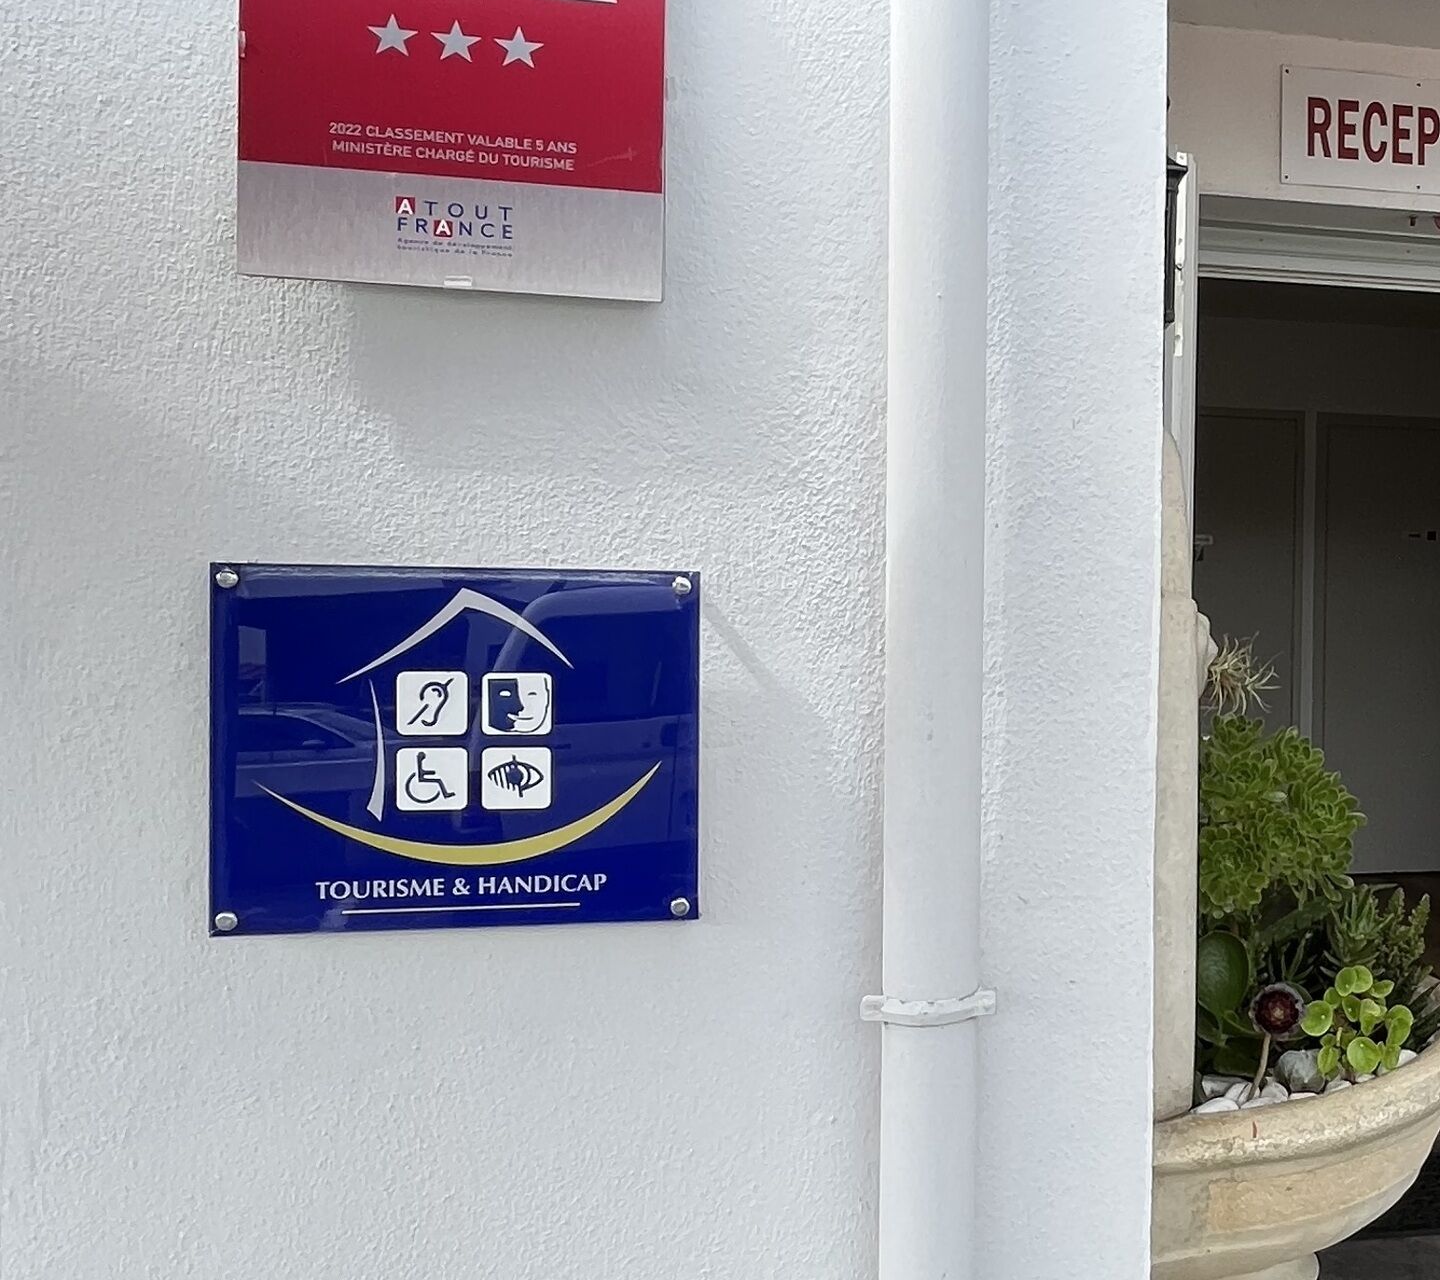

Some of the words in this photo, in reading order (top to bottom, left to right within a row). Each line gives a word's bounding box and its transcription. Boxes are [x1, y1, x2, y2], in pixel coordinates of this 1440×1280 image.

[328, 122, 362, 137] 2022
[365, 126, 465, 144] CLASSEMENT
[467, 133, 533, 151] VALABLE
[535, 140, 544, 152] 5
[546, 141, 578, 154] ANS
[332, 139, 412, 158] MINISTÈRE
[415, 147, 475, 163] CHARGÉ
[478, 151, 499, 165] DU
[502, 153, 576, 171] TOURISME
[397, 217, 513, 240] FRANCE
[315, 877, 445, 900] TOURISME
[452, 877, 470, 896] &
[478, 873, 608, 895] HANDICAP
